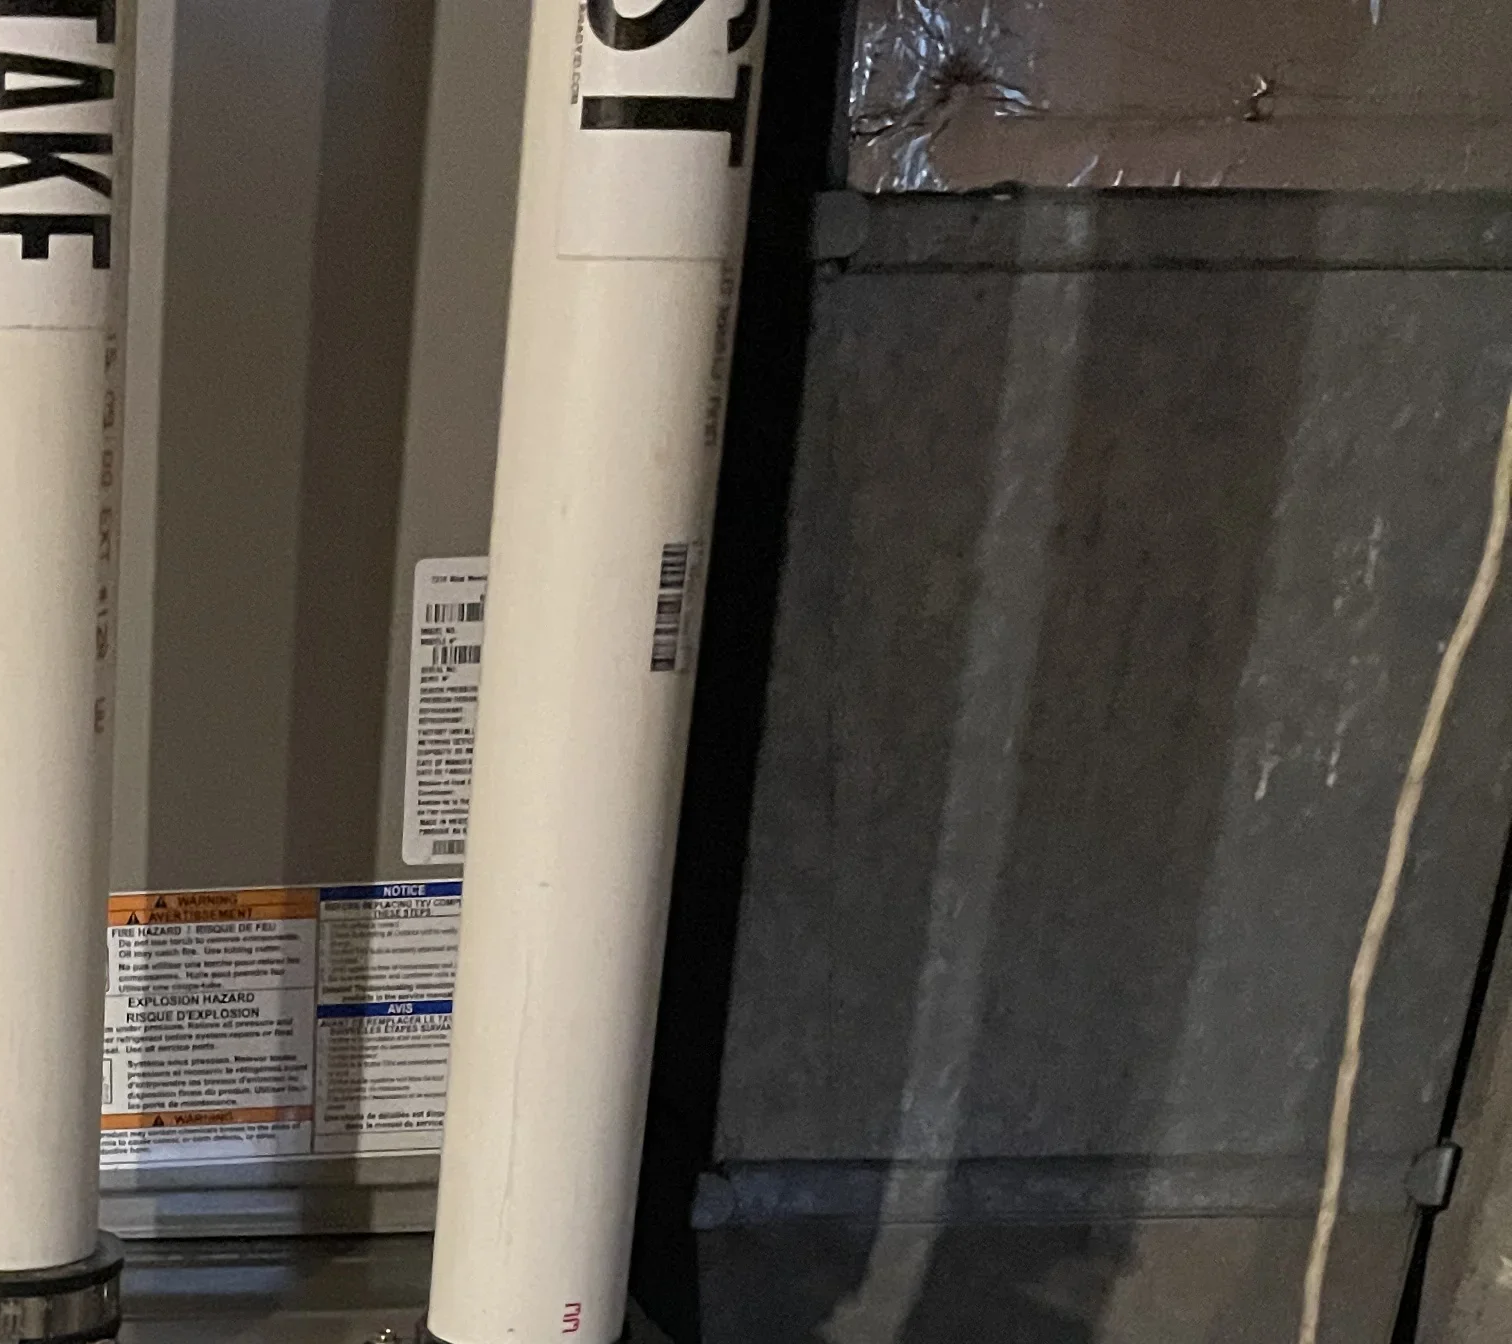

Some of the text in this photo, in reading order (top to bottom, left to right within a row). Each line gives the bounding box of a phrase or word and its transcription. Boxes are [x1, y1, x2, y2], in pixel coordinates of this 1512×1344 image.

[383, 885, 425, 897] NOTICE
[111, 927, 135, 939] FIRE
[138, 926, 182, 938] HAZARD
[238, 923, 253, 933] DE
[128, 992, 256, 1008] EXPLOSION HAZARD
[126, 1007, 260, 1023] RISQUE D'EXPLOSION
[387, 1003, 413, 1015] AVIS
